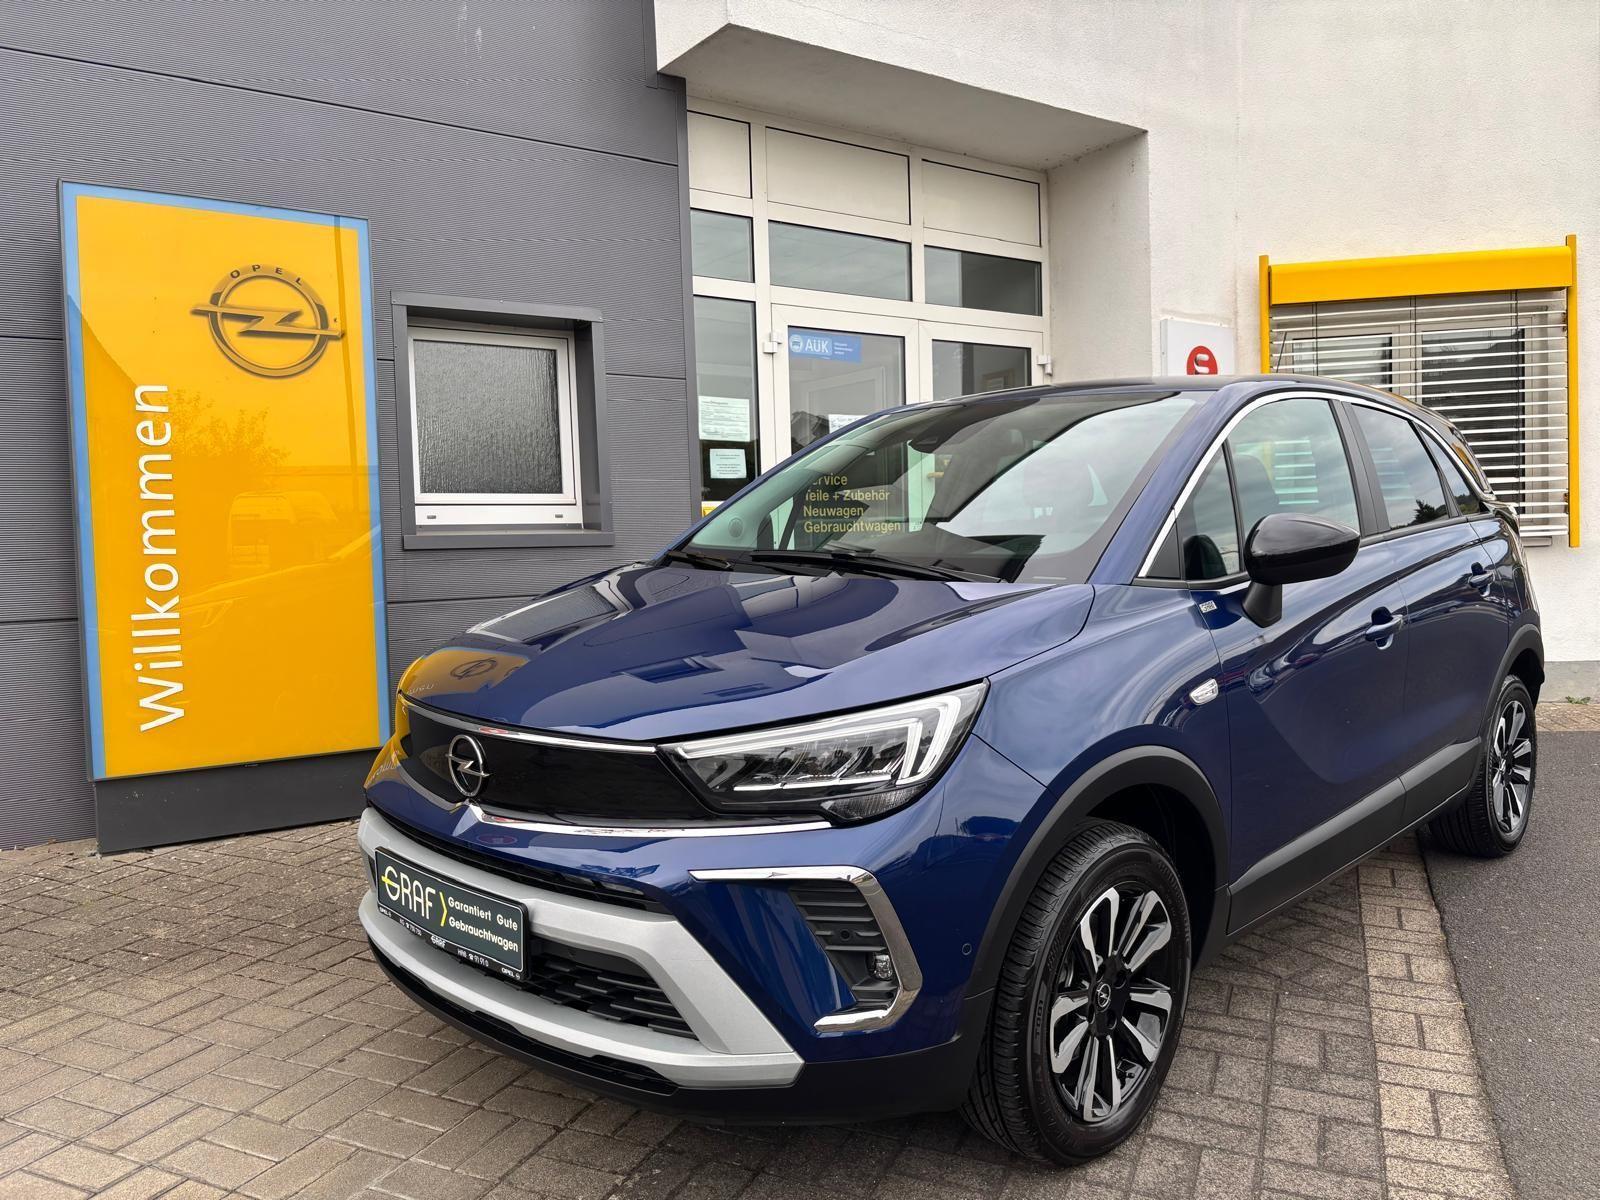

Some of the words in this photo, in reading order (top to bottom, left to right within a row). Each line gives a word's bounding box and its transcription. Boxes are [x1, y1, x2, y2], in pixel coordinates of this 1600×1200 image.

[230, 264, 303, 285] OPEL
[843, 489, 891, 501] Zubehör
[803, 506, 865, 518] Neuwagen
[804, 521, 901, 534] Gebrauchtwagen
[131, 384, 185, 732] Willkommen
[381, 866, 436, 920] GRAF
[448, 896, 491, 921] Garantiert
[496, 914, 518, 931] Gute
[448, 916, 519, 953] Gebrauchtwagen
